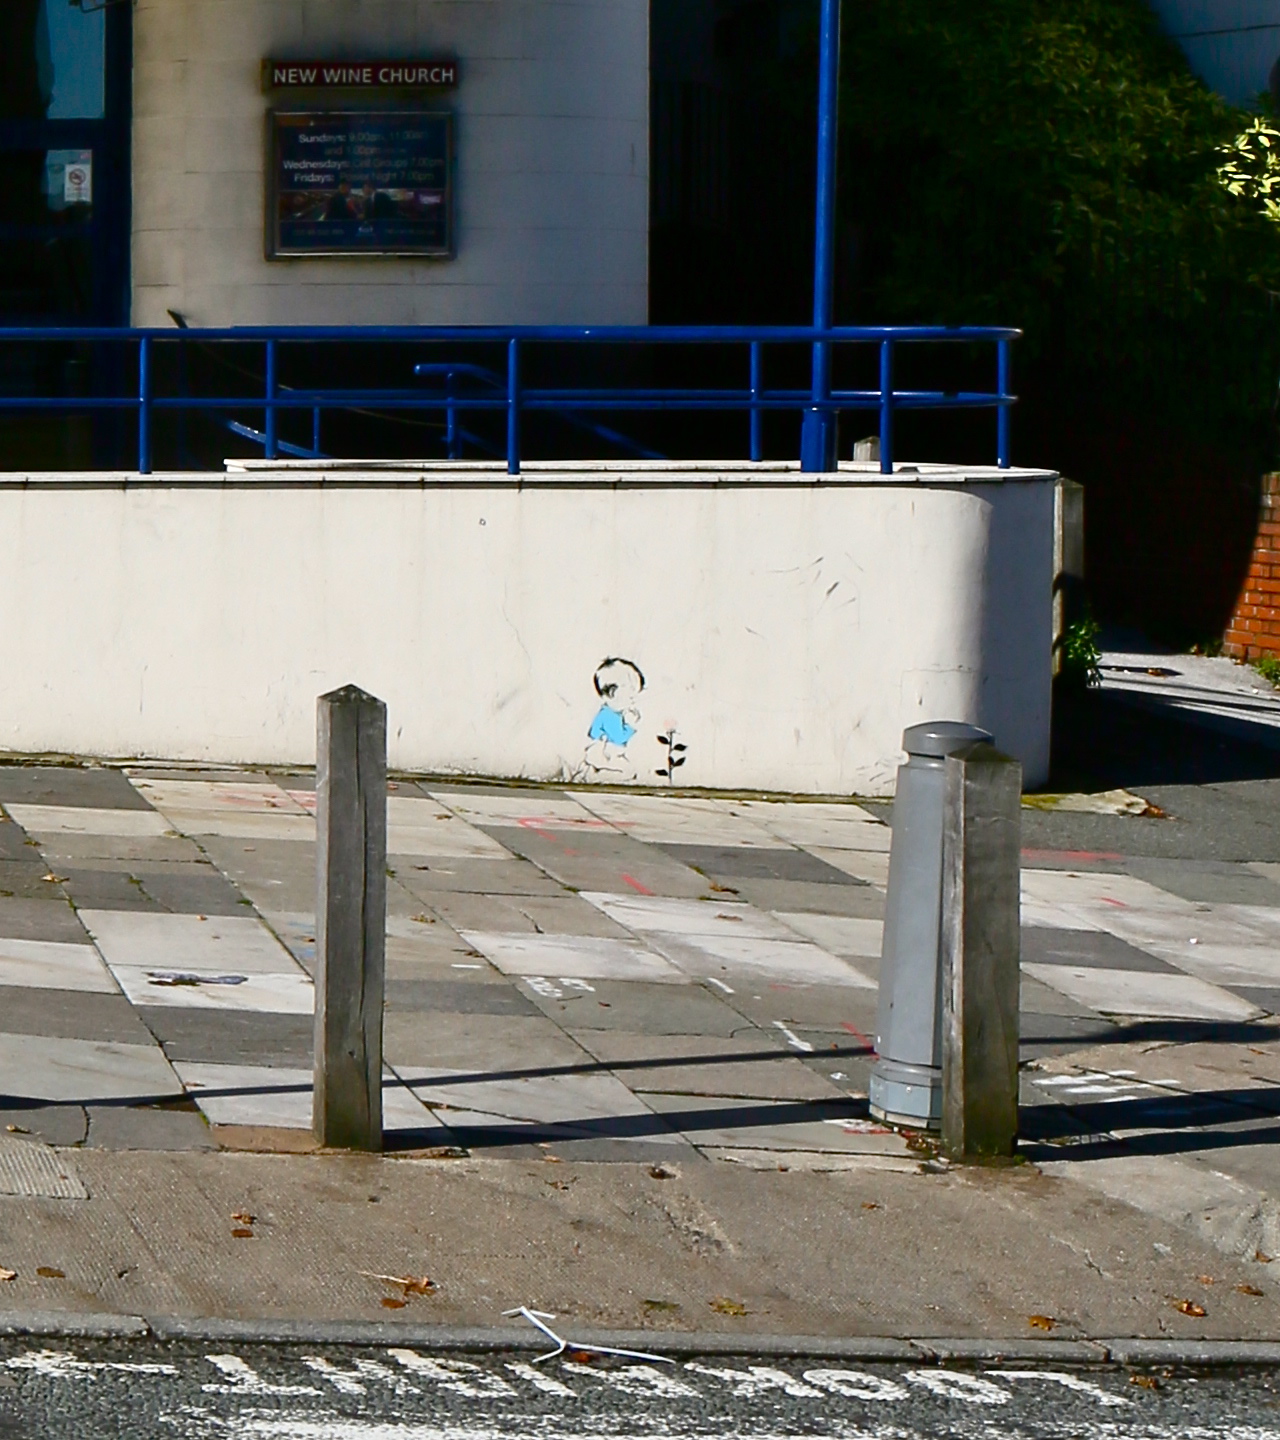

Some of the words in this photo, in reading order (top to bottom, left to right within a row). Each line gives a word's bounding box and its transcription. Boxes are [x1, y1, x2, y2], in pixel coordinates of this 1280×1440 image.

[274, 68, 317, 83] NEW
[324, 67, 372, 83] WINE
[379, 67, 455, 82] CHURCH
